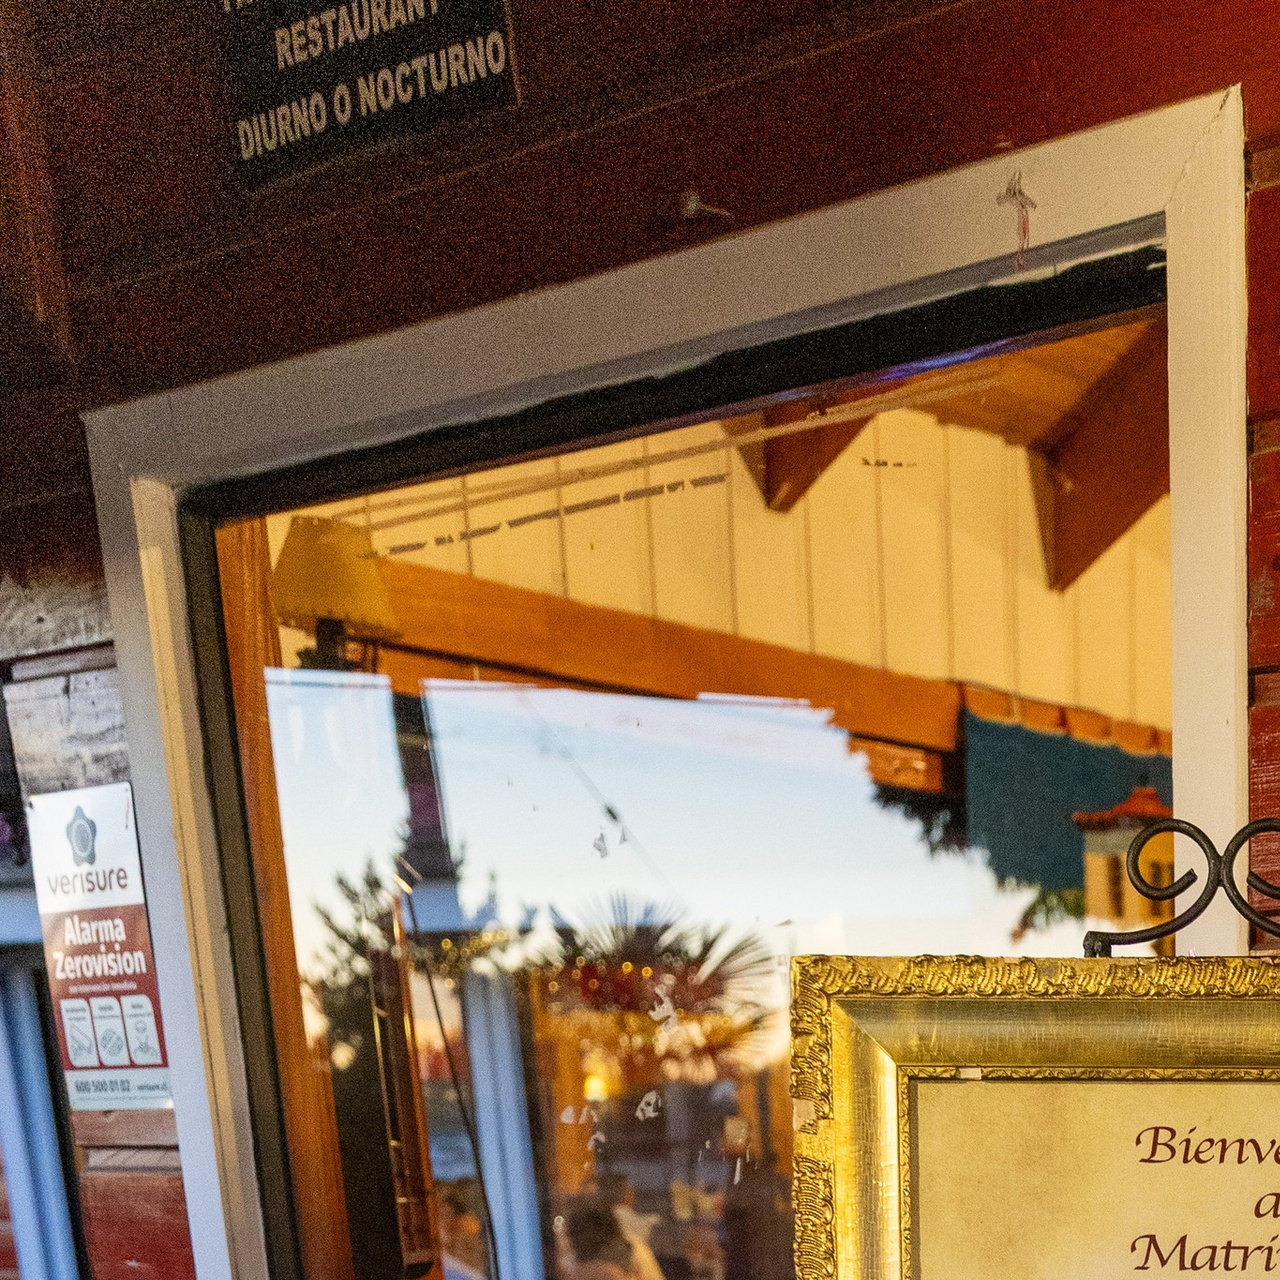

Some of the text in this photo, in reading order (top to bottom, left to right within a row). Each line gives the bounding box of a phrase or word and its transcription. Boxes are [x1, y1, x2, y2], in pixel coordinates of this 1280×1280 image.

[238, 30, 506, 161] DIURNO O NOCTURNO
[47, 867, 128, 895] verisure
[64, 914, 127, 945] Alarma
[52, 942, 147, 980] Zerovision
